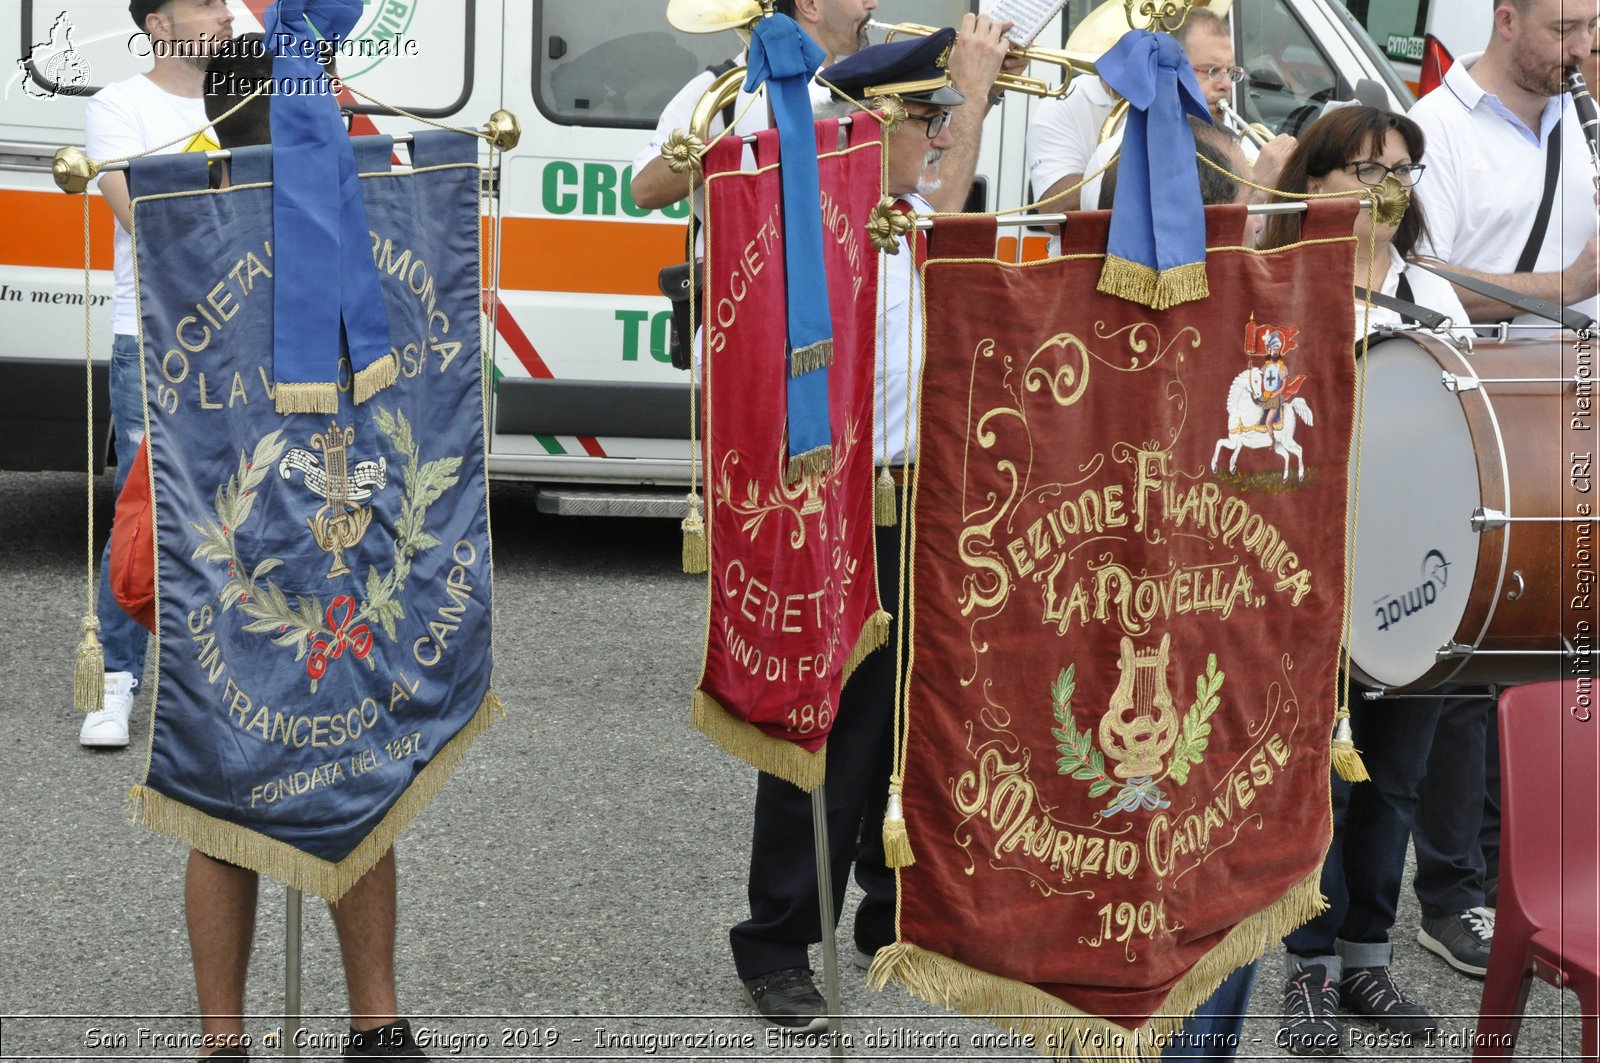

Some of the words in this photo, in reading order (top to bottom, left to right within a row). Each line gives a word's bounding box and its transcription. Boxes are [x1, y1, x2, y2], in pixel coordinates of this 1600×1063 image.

[0, 285, 23, 302] In
[711, 203, 780, 353] SOCIETA'
[158, 240, 273, 414] SOCIETA'
[199, 370, 249, 410] LA
[957, 484, 1128, 617] SEZIONE
[1130, 448, 1312, 607] FILARMONICA
[1375, 580, 1437, 632] amat
[187, 603, 226, 685] SAN
[221, 678, 378, 749] FRANCESCO
[388, 672, 420, 712] AL
[413, 539, 477, 668] CAMPO
[766, 655, 787, 683] DI
[787, 690, 834, 734] 186
[251, 761, 345, 809] FONDATA
[352, 750, 383, 778] NEL
[385, 732, 421, 762] 1897
[1146, 732, 1291, 880] CANAVESE
[1097, 898, 1167, 943] 1904
